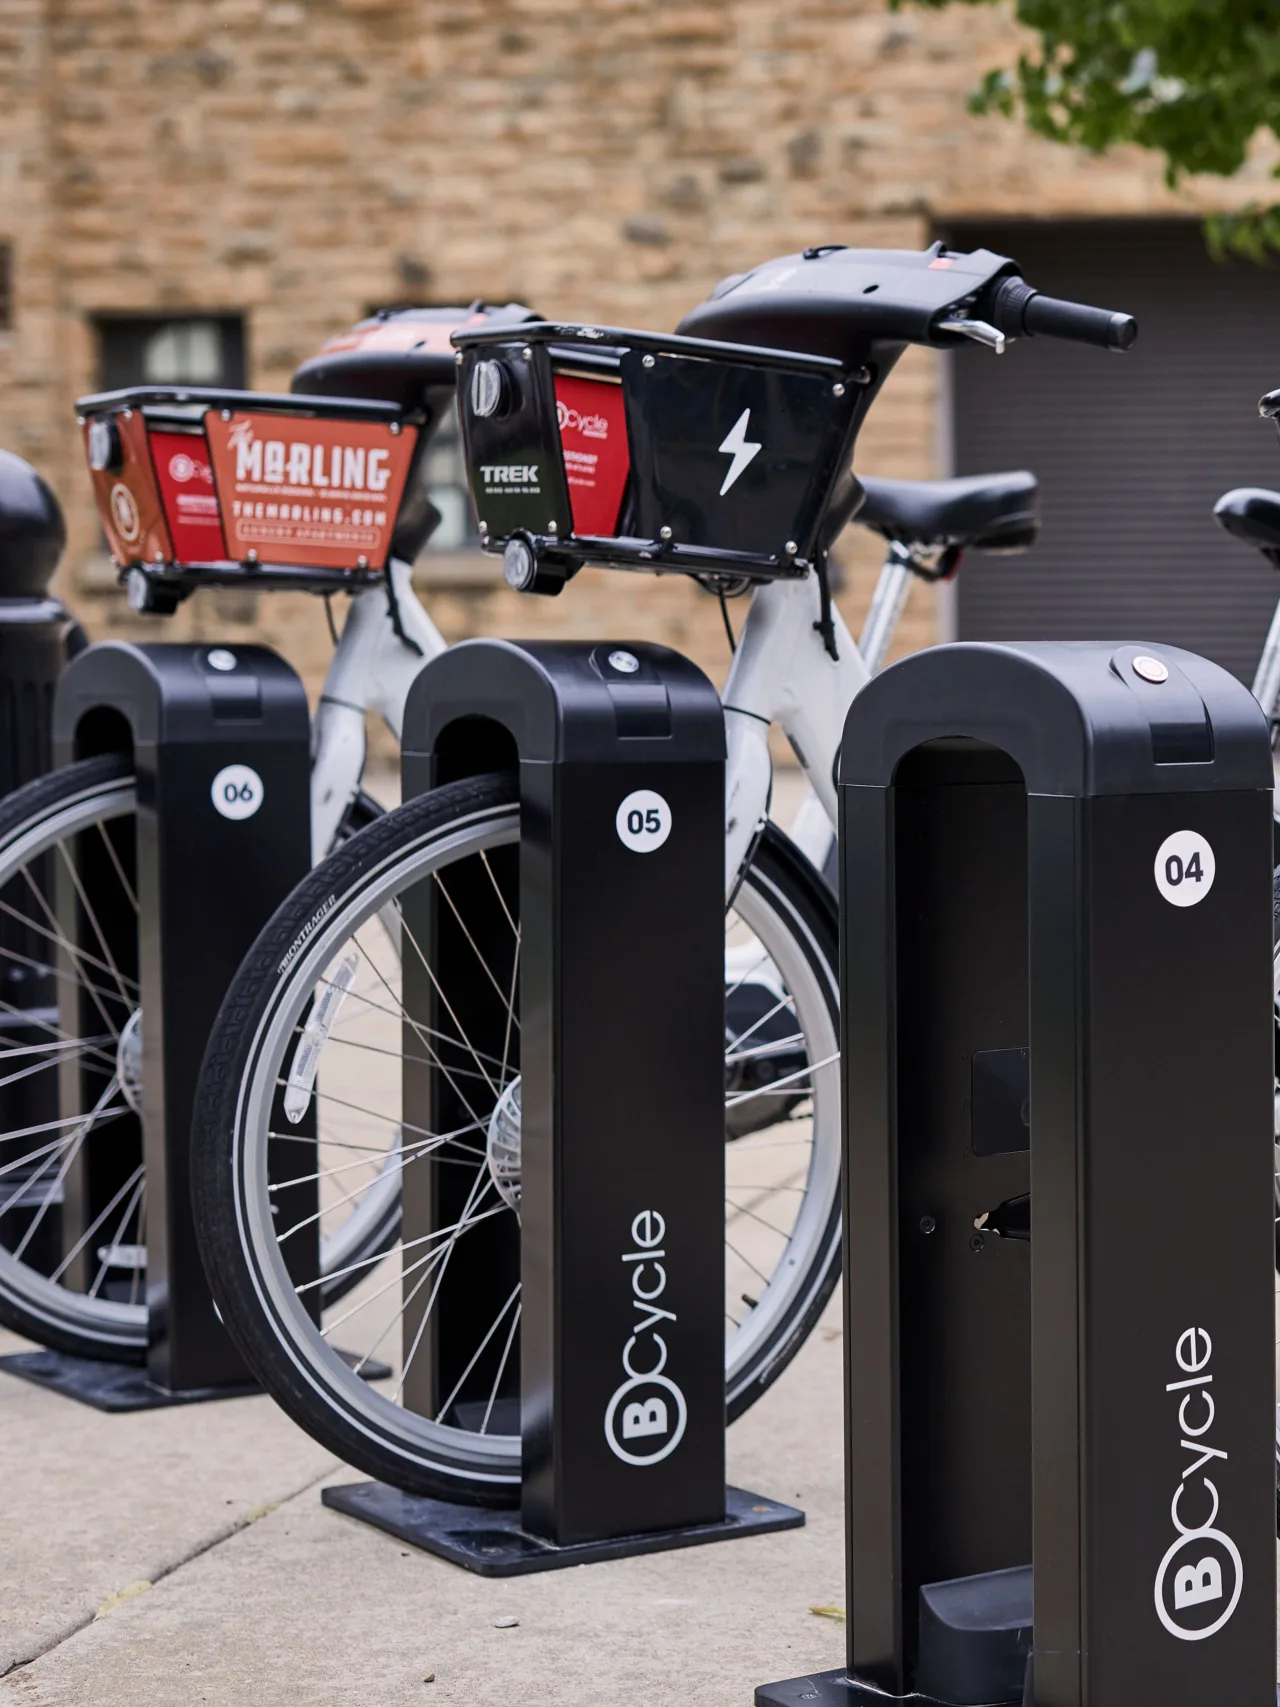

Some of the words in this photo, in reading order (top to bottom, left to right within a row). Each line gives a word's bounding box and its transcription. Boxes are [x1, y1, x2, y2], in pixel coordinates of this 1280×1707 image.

[236, 439, 391, 491] MARLING
[479, 465, 539, 483] TREK
[223, 783, 254, 805] 06
[627, 808, 662, 835] 05
[1165, 851, 1204, 887] 04
[604, 1209, 688, 1467] BCycle
[1154, 1326, 1244, 1641] BCycle
